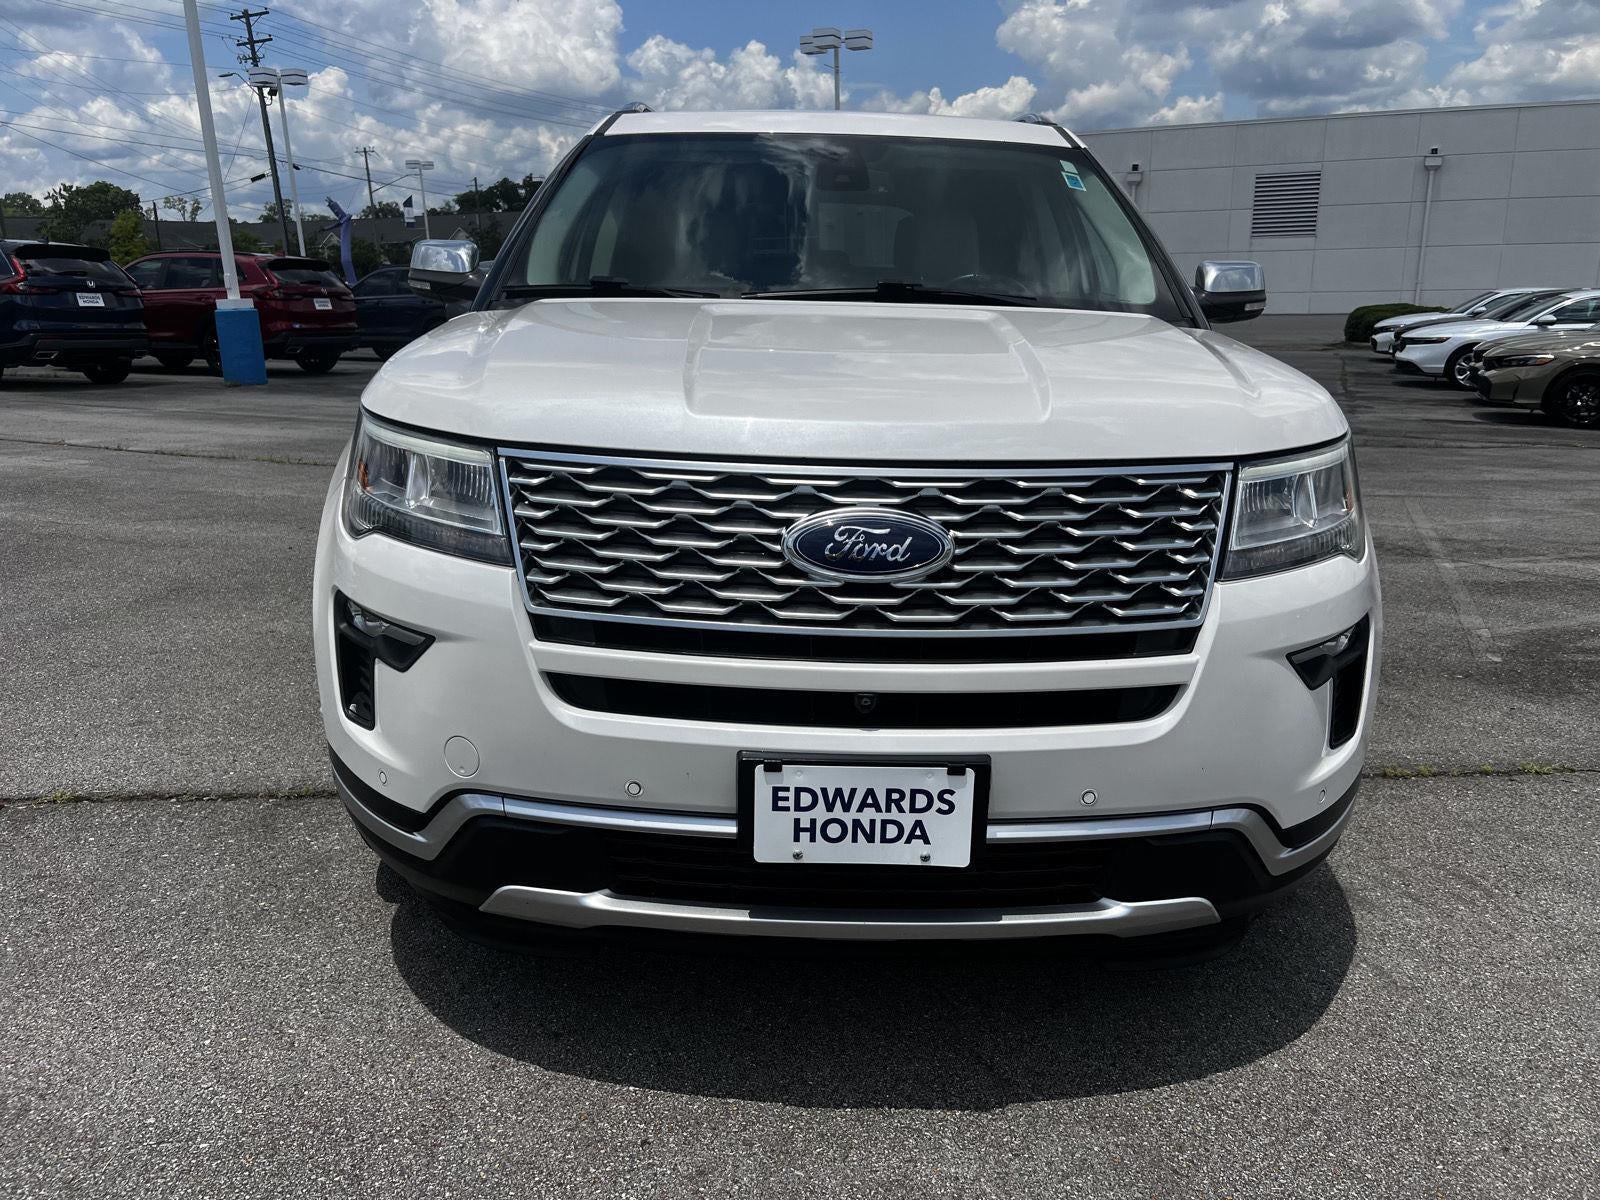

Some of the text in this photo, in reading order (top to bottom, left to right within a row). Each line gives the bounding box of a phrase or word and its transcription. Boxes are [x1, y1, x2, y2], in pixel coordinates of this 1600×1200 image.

[824, 525, 913, 562] Ford
[771, 785, 957, 816] EDWARDS
[793, 817, 932, 846] HONDA
